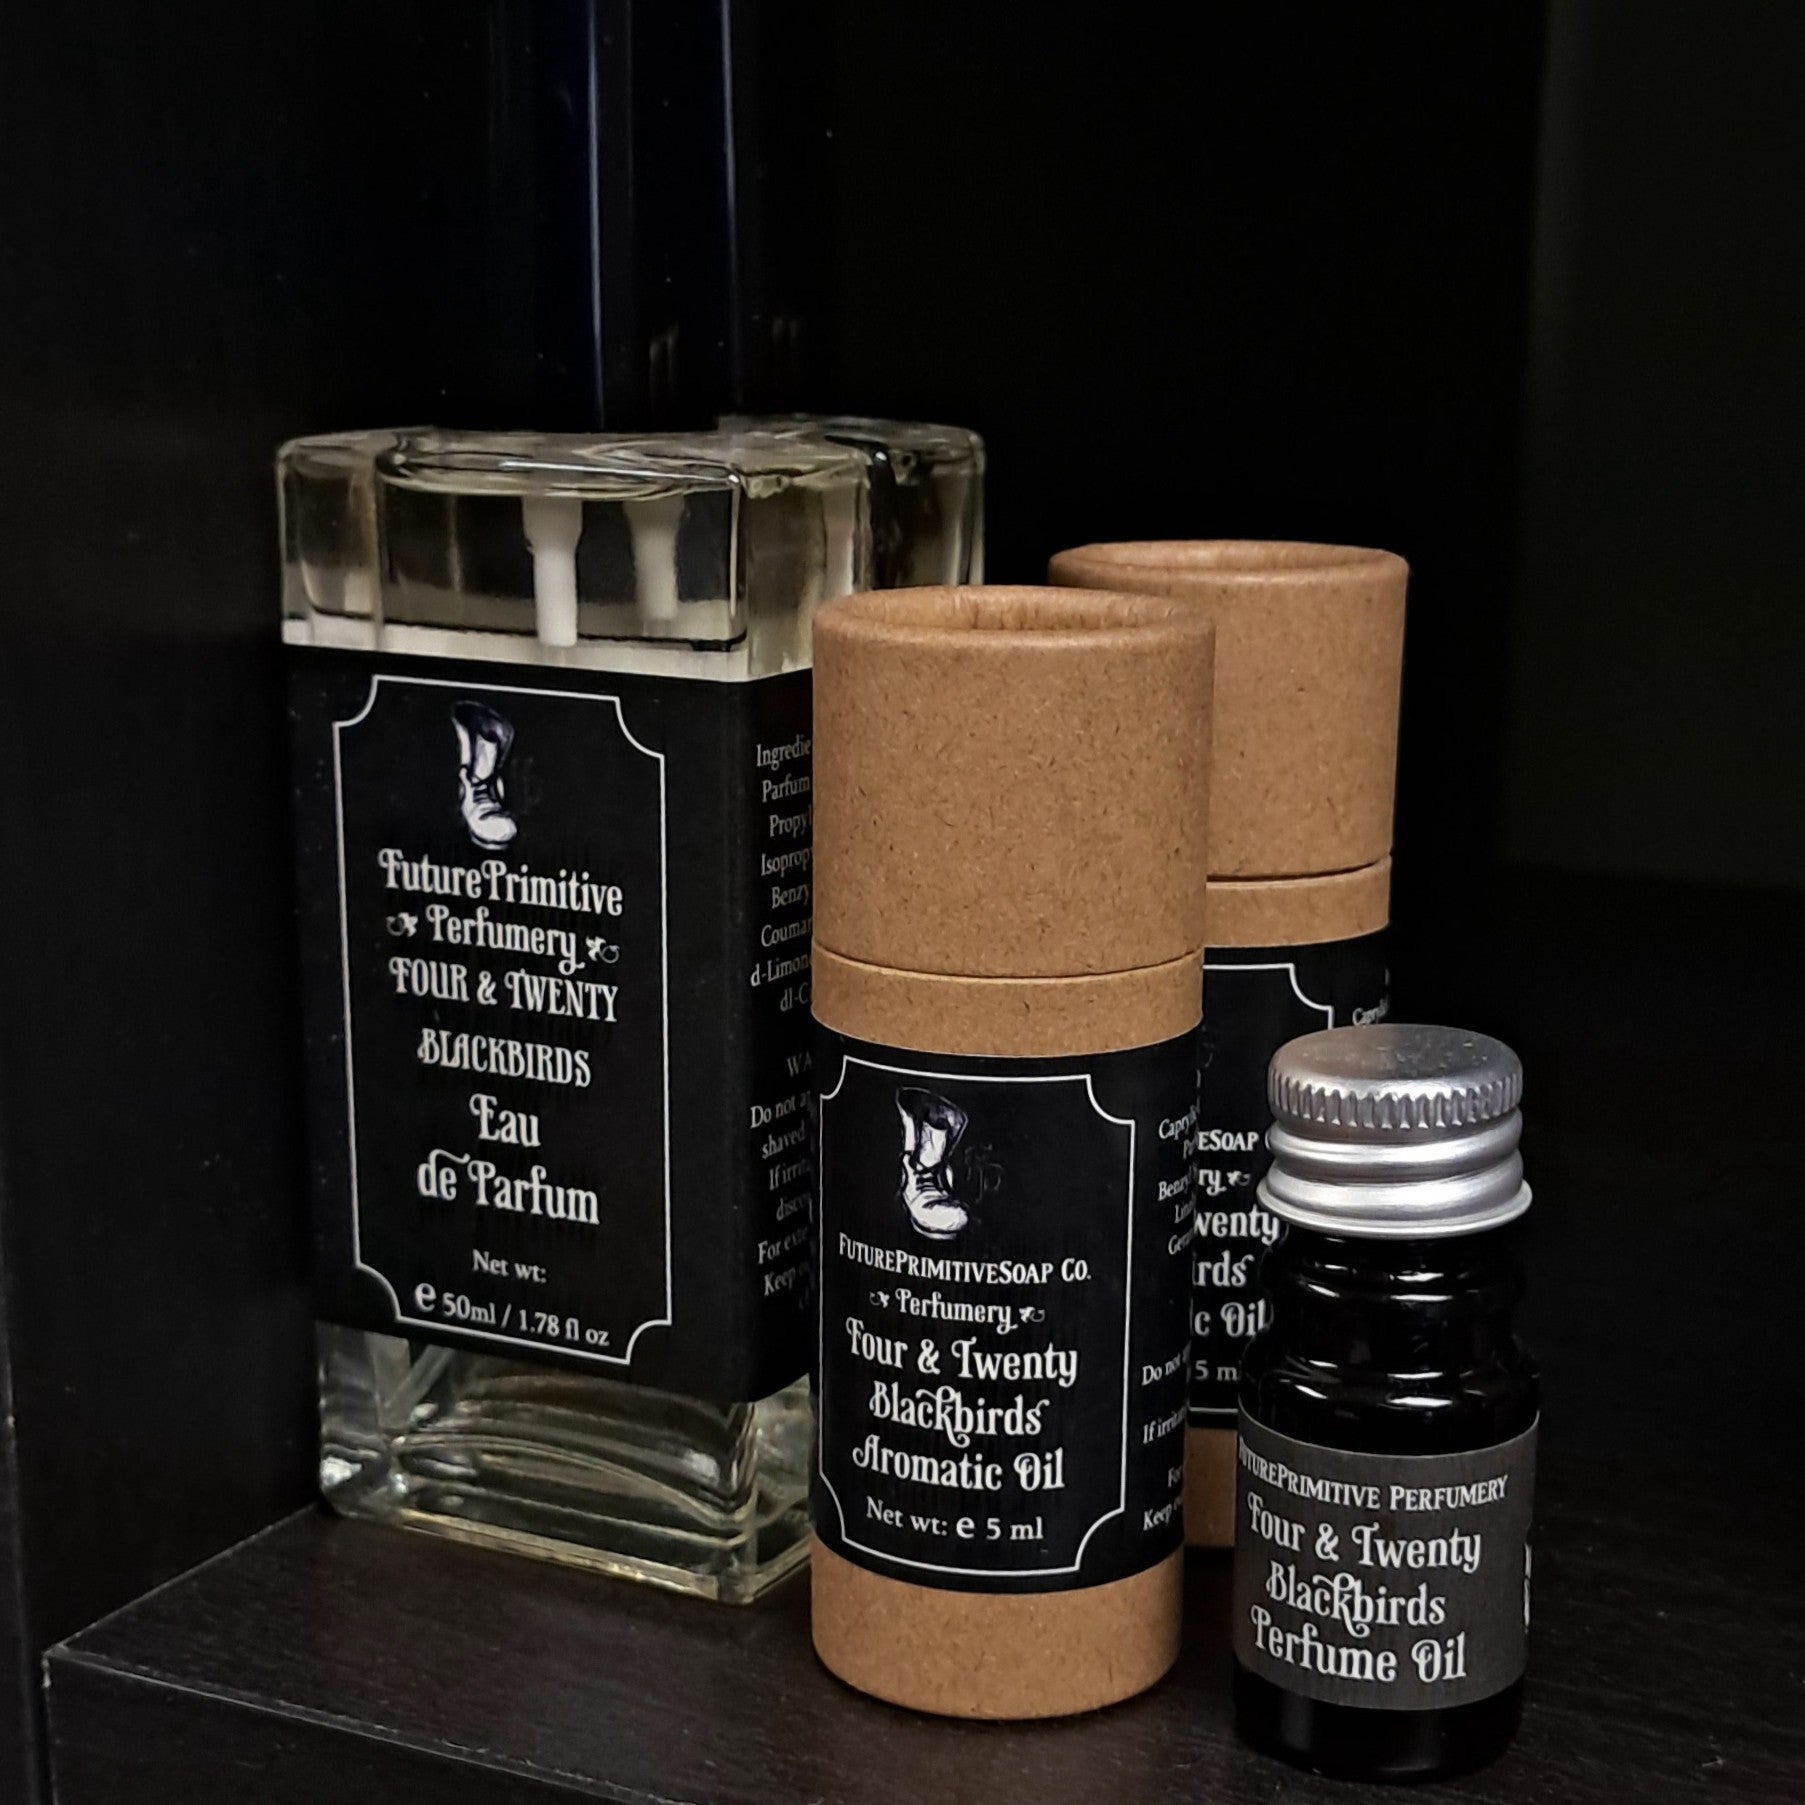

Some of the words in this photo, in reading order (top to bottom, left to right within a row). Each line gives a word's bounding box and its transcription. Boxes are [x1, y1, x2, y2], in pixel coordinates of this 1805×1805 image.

[377, 848, 623, 916] FuturePrimitive
[425, 904, 585, 975] Perfumery
[389, 956, 469, 1002] FOUR
[477, 971, 498, 1006] &
[504, 969, 619, 1022] TWENTY
[417, 1028, 591, 1087] BLACKBIRDS
[469, 1093, 541, 1147] Eau
[750, 1105, 772, 1129] Do
[417, 1149, 470, 1200] de
[467, 1160, 599, 1225] Parfum
[472, 1249, 508, 1278] Net
[514, 1262, 547, 1284] wt:
[758, 1240, 781, 1264] For
[839, 1232, 1053, 1284] FUTUREPRIMITIVESOAP
[1061, 1258, 1091, 1282] CO.
[443, 1293, 496, 1325] 50ml
[501, 1304, 512, 1327] /
[519, 1309, 560, 1337] 1.78
[564, 1317, 580, 1341] fl
[585, 1327, 609, 1346] oz
[895, 1288, 1018, 1335] Perfumery
[846, 1317, 908, 1369] Four
[917, 1338, 941, 1374] &
[951, 1337, 1077, 1388] Twenty
[1141, 1364, 1163, 1386] Do
[1195, 1359, 1209, 1381] 5
[869, 1381, 1050, 1448] Blackbirds
[852, 1434, 1002, 1491] Aromatic
[1014, 1447, 1065, 1491] Oil
[866, 1496, 903, 1527] Net
[910, 1514, 948, 1536] wt:
[986, 1518, 1001, 1539] 5
[1009, 1516, 1044, 1540] ml
[1389, 1474, 1509, 1512] PERFUMERY
[1247, 1491, 1306, 1552] Four
[1314, 1522, 1340, 1562] &
[1352, 1521, 1482, 1575] Twenty
[1265, 1560, 1447, 1638] Blackbirds
[1250, 1604, 1398, 1683] Perfume
[1411, 1630, 1467, 1683] Oil
